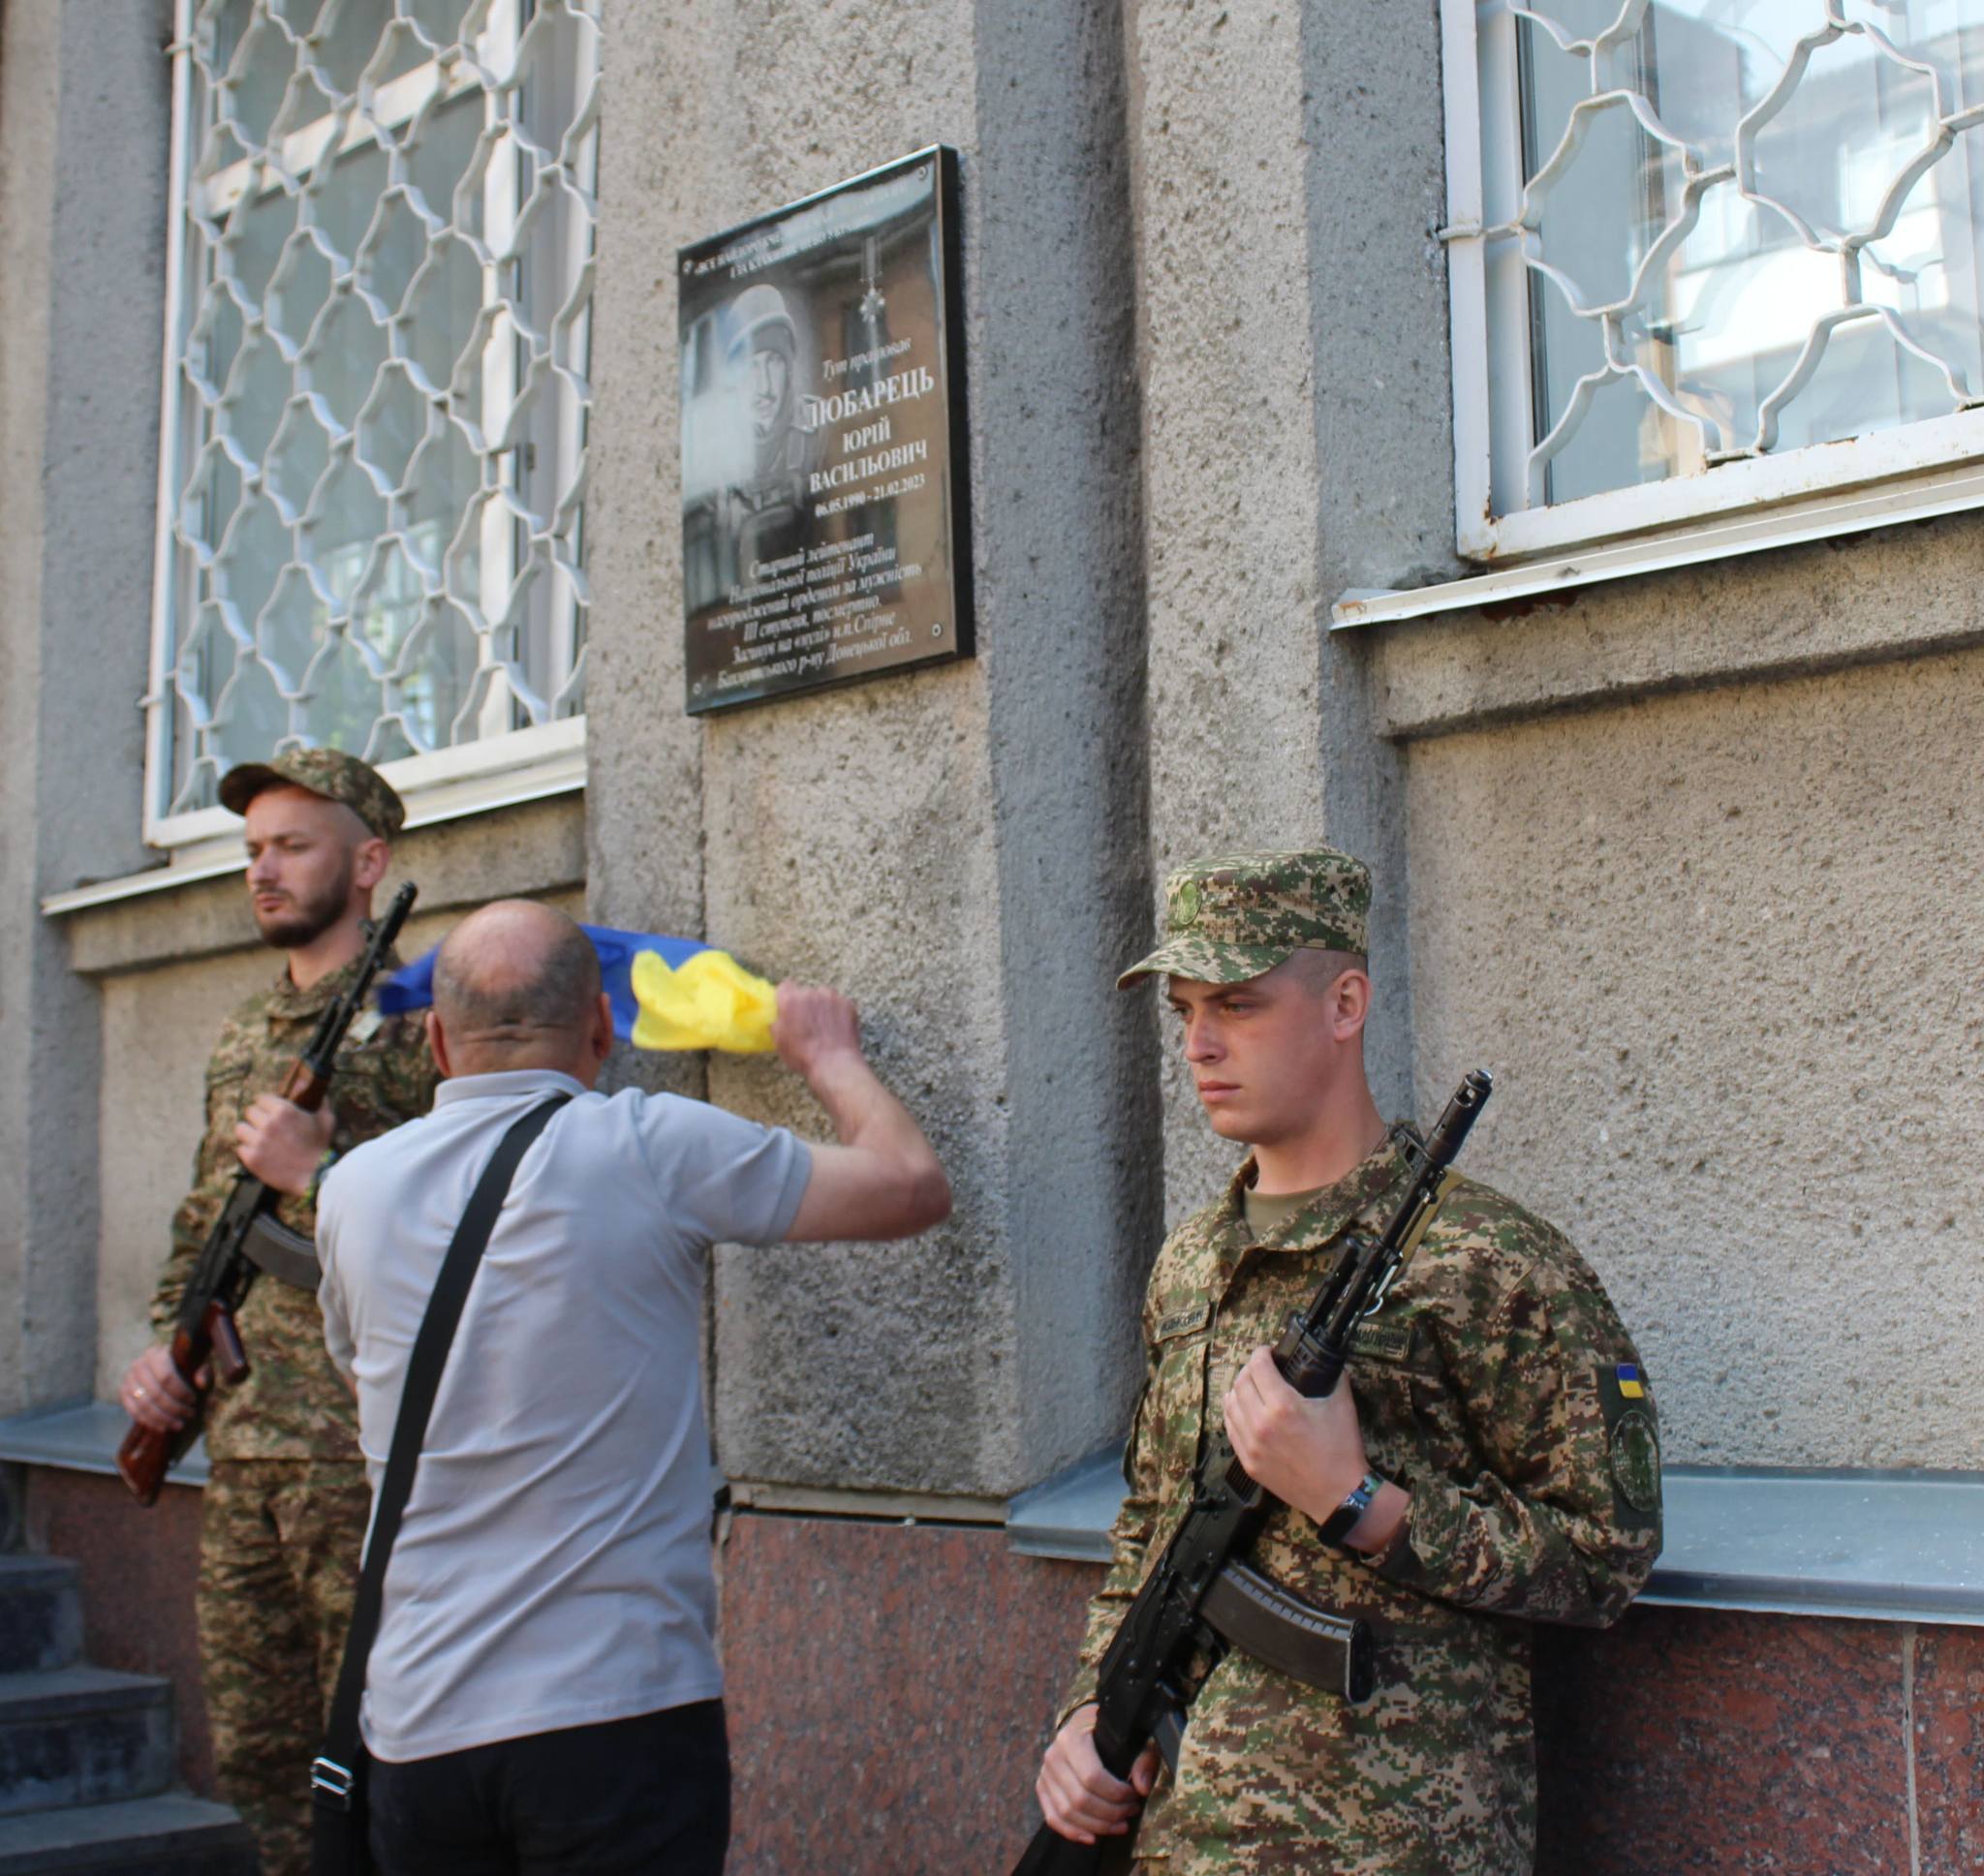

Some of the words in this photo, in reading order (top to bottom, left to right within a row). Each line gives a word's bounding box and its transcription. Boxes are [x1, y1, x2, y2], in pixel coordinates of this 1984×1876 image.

[806, 366, 934, 428] ЛЮБАРЕЦЬ
[843, 415, 890, 453] ЮРІЙ
[810, 439, 927, 493] ВАСИЛЬОВИЧ
[873, 473, 925, 501] 21.02.2023
[807, 557, 846, 581] поліції
[849, 547, 897, 572] України
[843, 580, 855, 595] за
[858, 563, 921, 593] мужність
